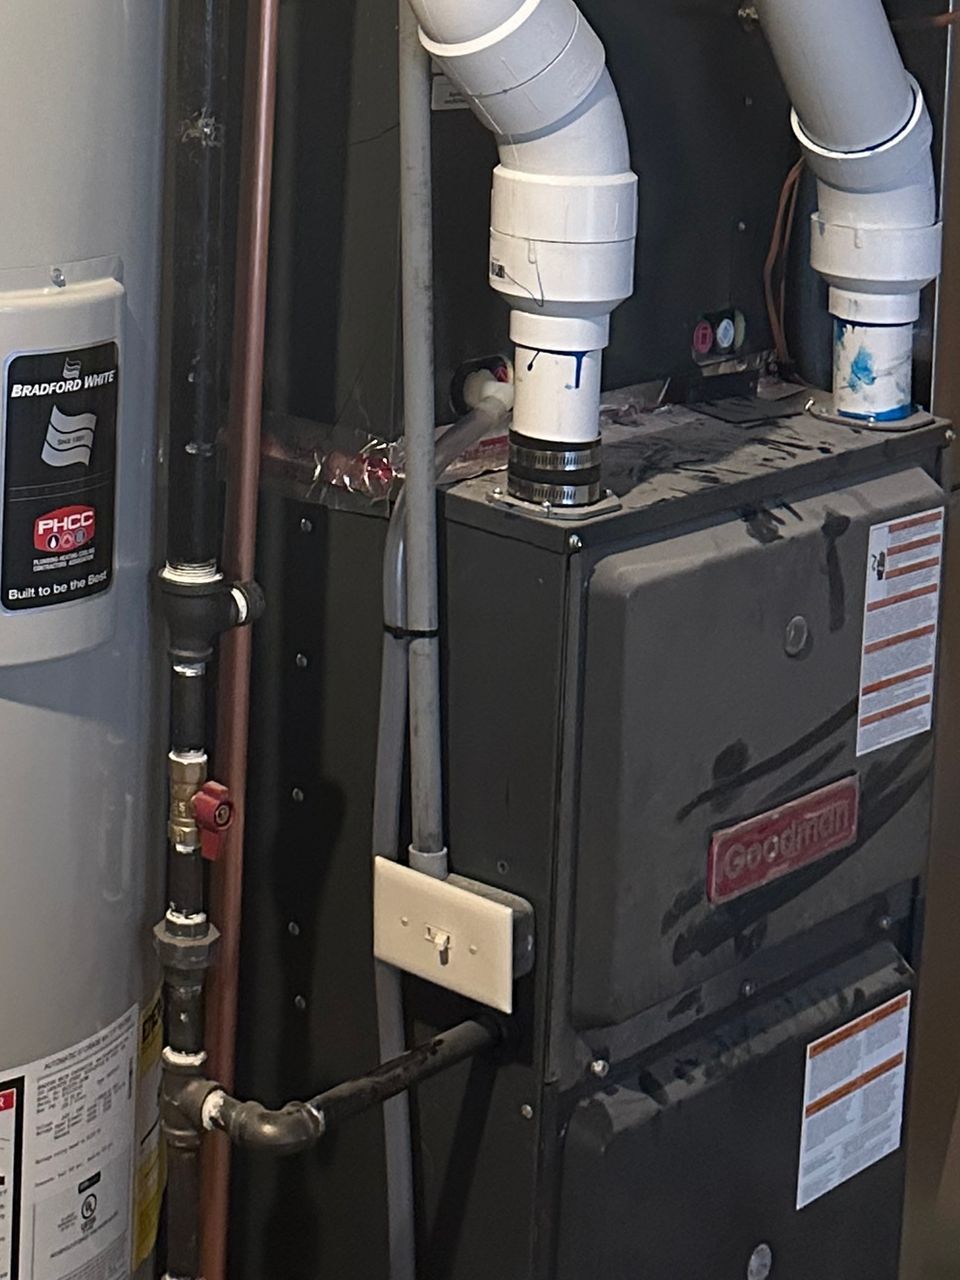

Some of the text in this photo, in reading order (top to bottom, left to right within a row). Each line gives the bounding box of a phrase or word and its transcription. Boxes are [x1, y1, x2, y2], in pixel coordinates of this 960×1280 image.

[11, 369, 117, 398] BRADFORD WHITE
[37, 511, 94, 535] PHCC
[8, 570, 107, 600] Built to be the Best
[724, 800, 849, 879] Goodman
